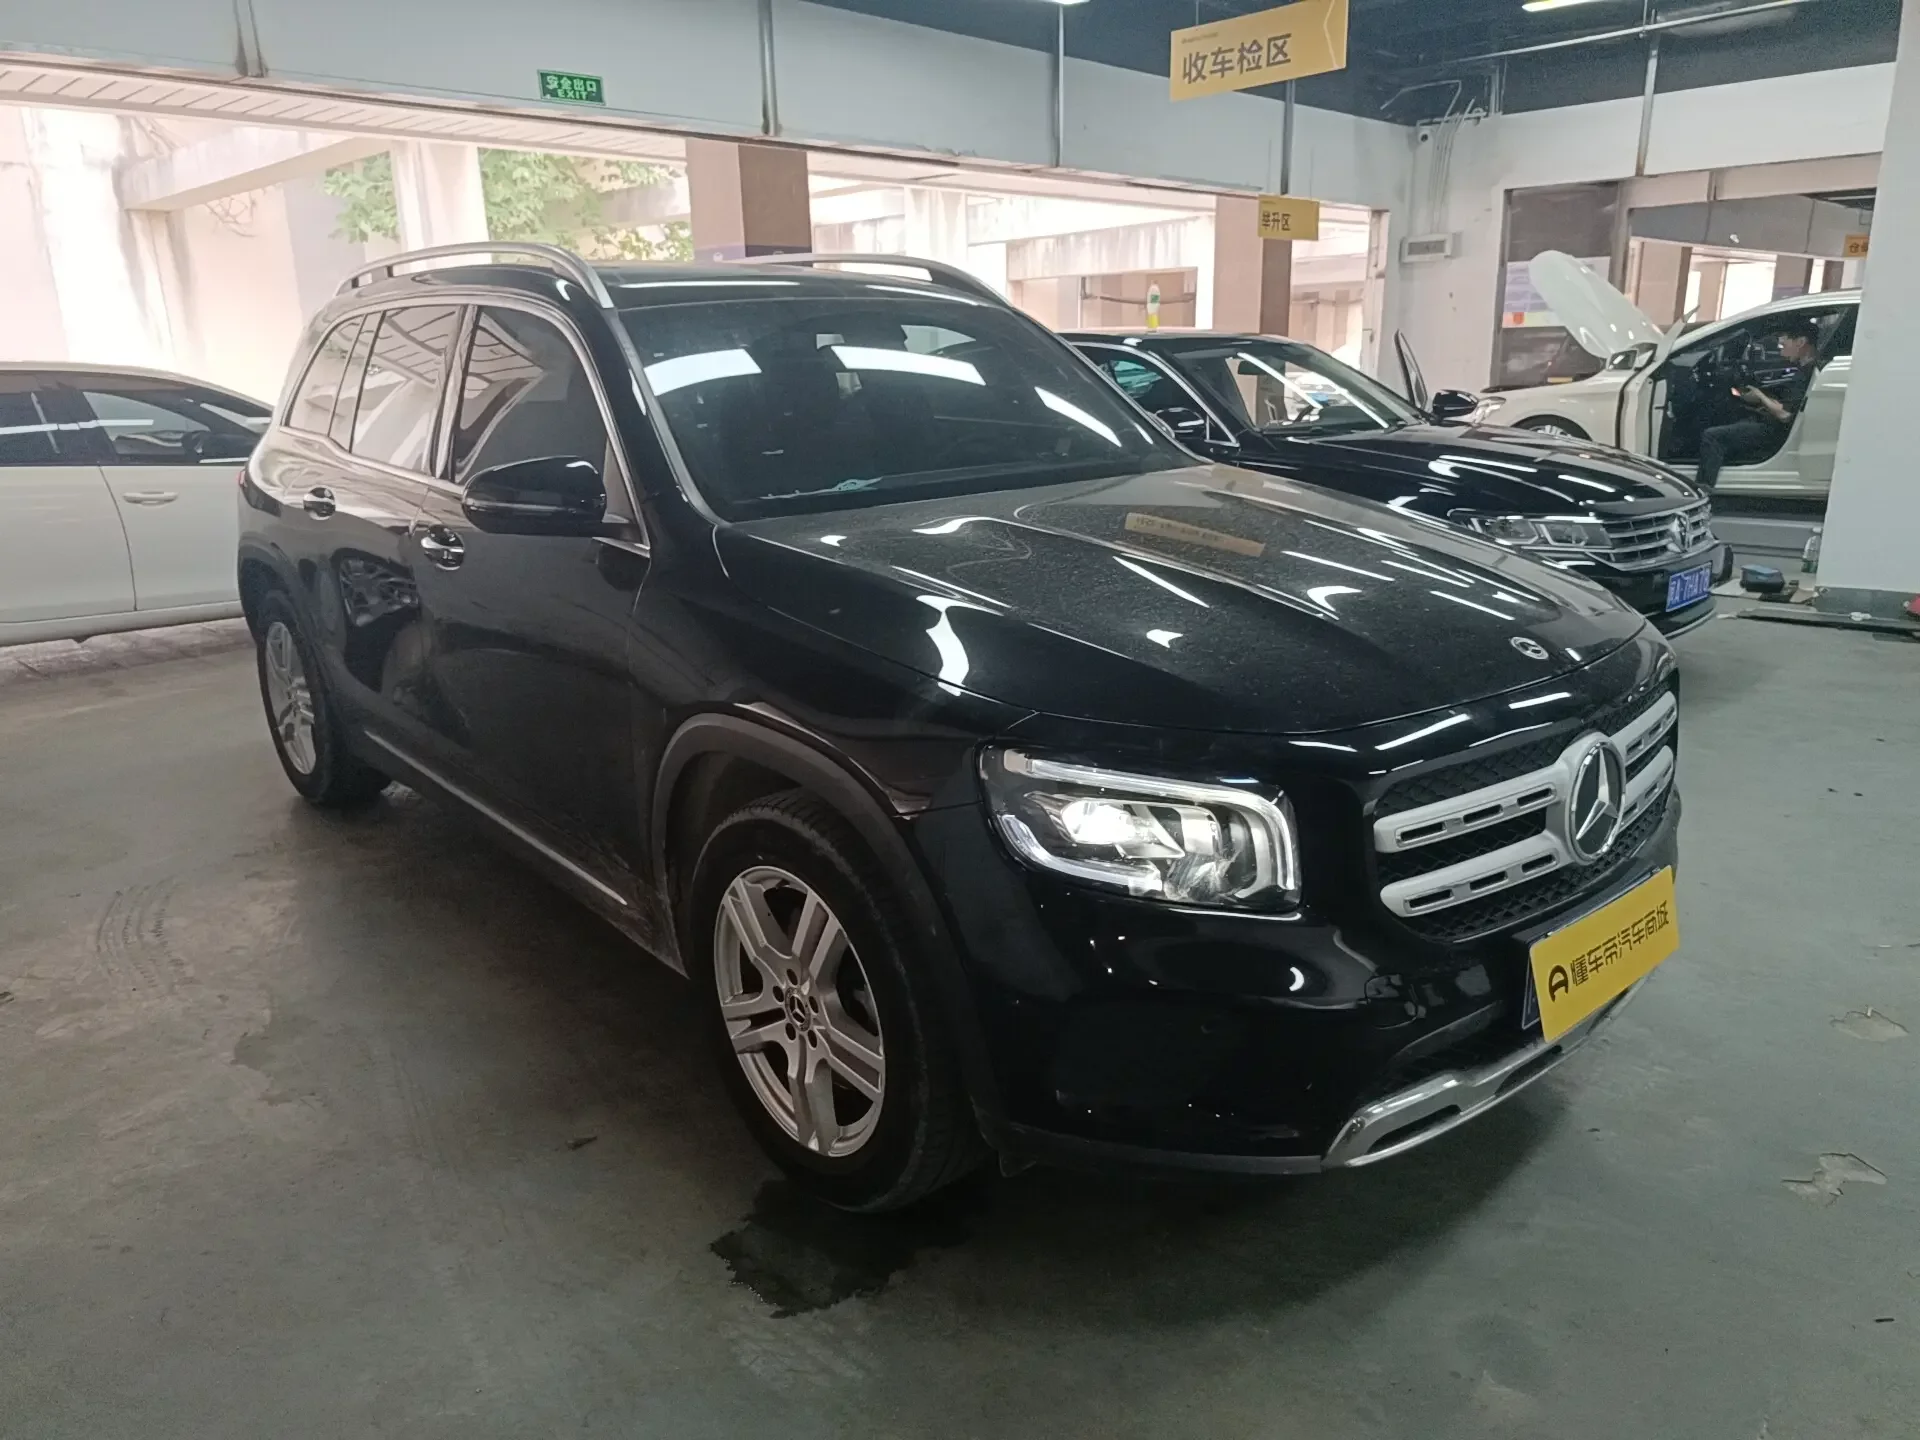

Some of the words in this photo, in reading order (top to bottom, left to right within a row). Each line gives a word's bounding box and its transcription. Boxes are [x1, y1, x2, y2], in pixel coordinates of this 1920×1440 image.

[1182, 33, 1292, 84] 收车检区
[546, 75, 597, 92] 安全出口
[557, 89, 588, 100] EXIT
[1570, 900, 1669, 986] 懂车帝汽车商城
